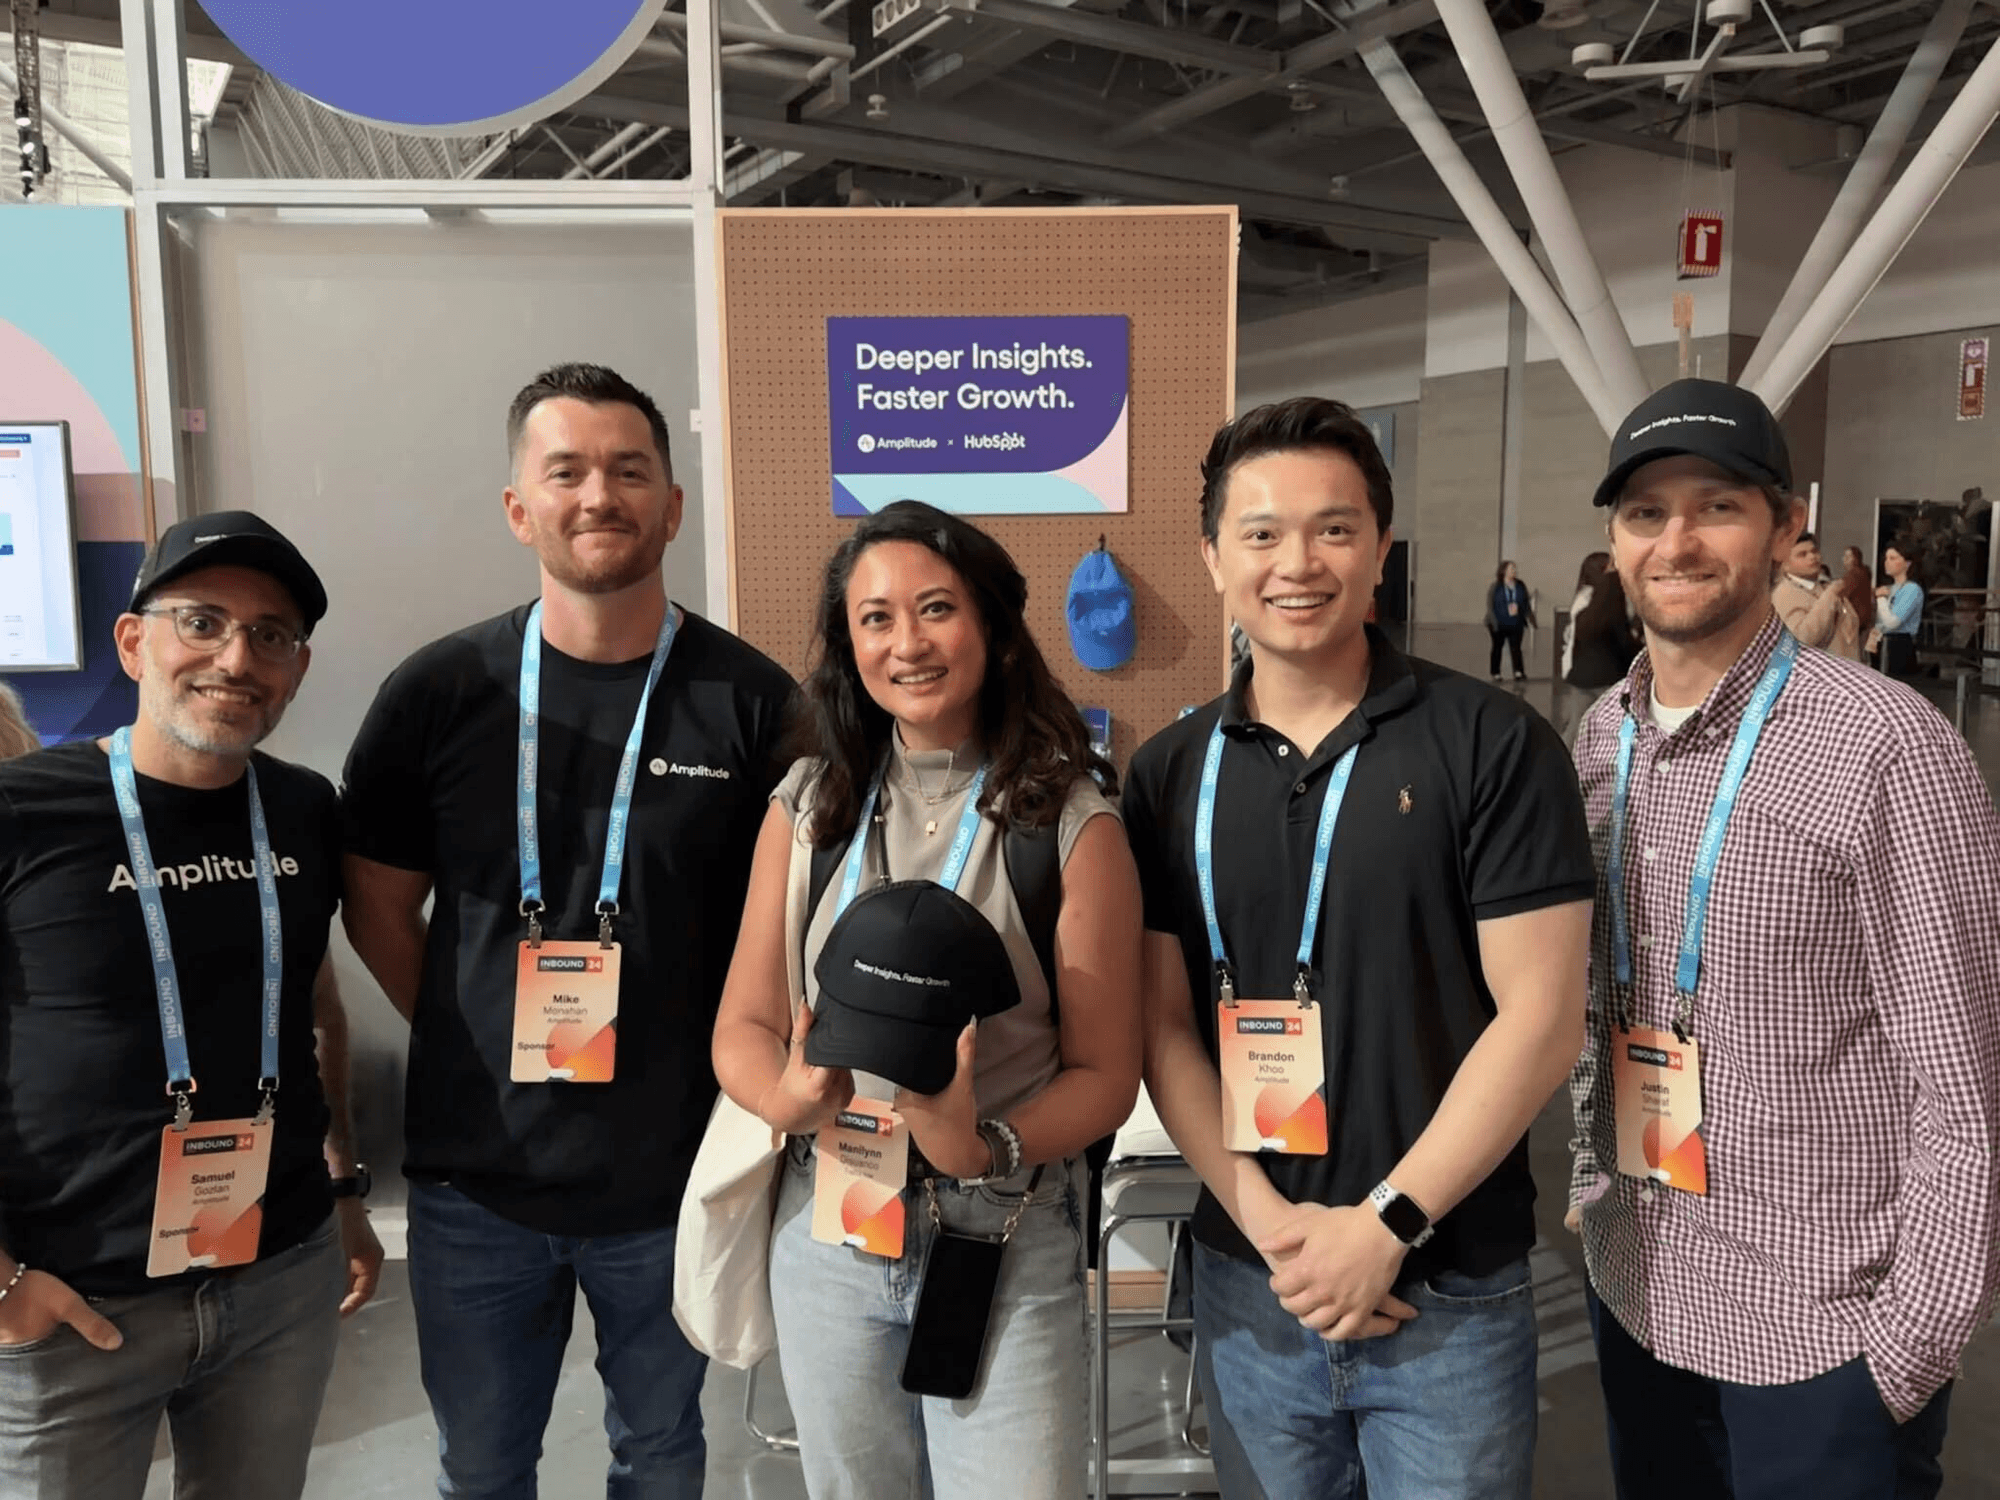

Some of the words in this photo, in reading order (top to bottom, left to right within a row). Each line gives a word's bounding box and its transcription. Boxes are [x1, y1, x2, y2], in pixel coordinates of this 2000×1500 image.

[857, 343, 964, 375] Deeper
[972, 342, 1093, 375] Insights.
[857, 383, 949, 410] Faster
[957, 382, 1075, 410] Growth.
[877, 436, 937, 450] Amplitude
[964, 431, 1026, 451] HubSpot
[1747, 668, 1780, 725] INBOUND
[524, 739, 535, 793] INBOUND
[669, 763, 730, 779] Amplitude
[1721, 739, 1748, 801] INBOUND
[130, 832, 152, 888] INBOUND
[524, 806, 535, 862] INBOUND
[608, 809, 624, 865] INBOUND
[945, 826, 970, 881] INBOUND
[1698, 816, 1722, 877] INBOUND
[257, 841, 274, 894] INBOUND
[1308, 863, 1323, 922] INBOUND
[146, 903, 166, 963] INBOUND
[267, 906, 279, 963] INBOUND
[1685, 893, 1701, 955] INBOUND
[540, 960, 584, 968] INBOUND
[160, 977, 178, 1038] INBOUND
[268, 978, 279, 1037] INBOUND
[543, 1006, 588, 1015] Monahan
[553, 994, 579, 1003] Mike
[517, 1041, 555, 1051] Sponsor
[1239, 1021, 1283, 1030] INBOUND
[1287, 1022, 1300, 1031] 24
[1249, 1051, 1295, 1062] Brandon
[1259, 1063, 1284, 1074] Khoo
[1641, 1081, 1669, 1094] Justin
[186, 1138, 234, 1150] INBOUND
[191, 1171, 235, 1184] Samuel
